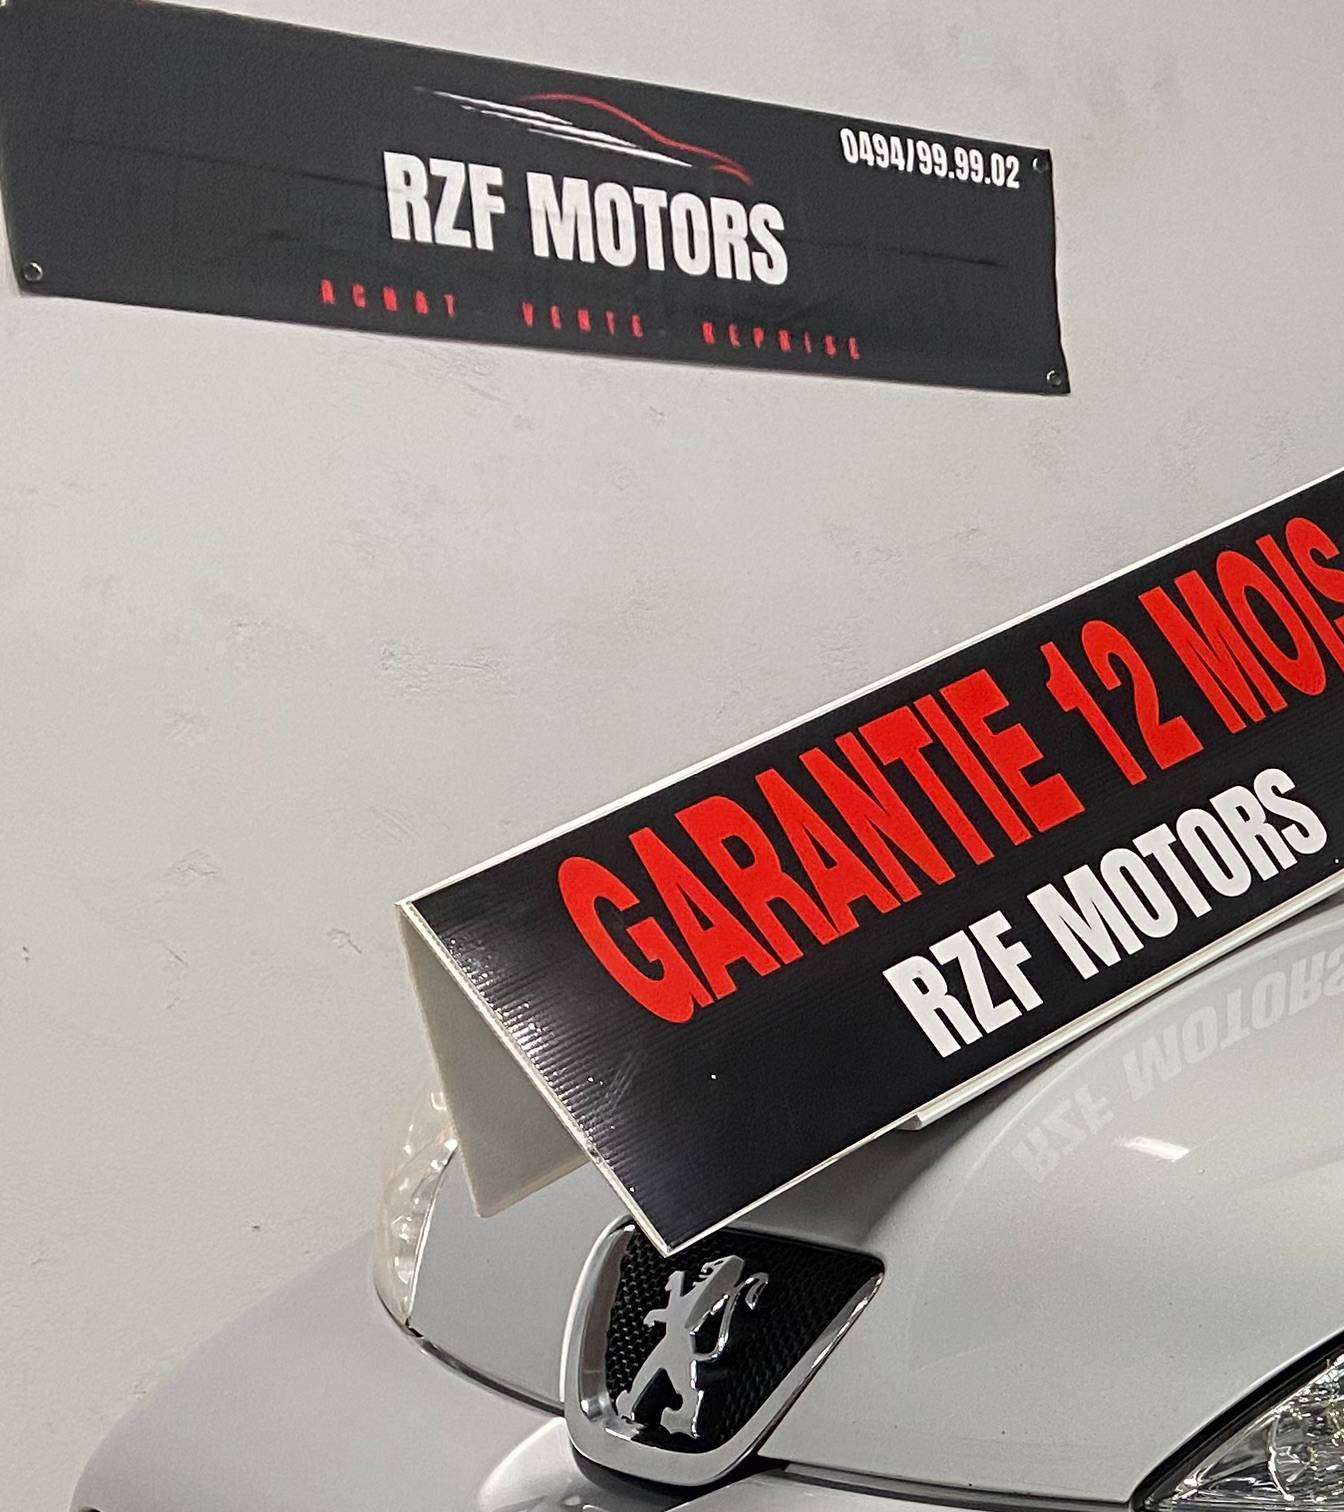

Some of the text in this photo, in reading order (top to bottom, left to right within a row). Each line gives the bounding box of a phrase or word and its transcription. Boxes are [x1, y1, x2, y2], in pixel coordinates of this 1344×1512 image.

[383, 151, 788, 286] RZF MOTORS
[840, 128, 1020, 189] 0494/99.99.02
[557, 668, 1082, 1025] GARANTIE
[1039, 618, 1203, 786] 12
[882, 768, 1328, 1058] RZF MOTORS
